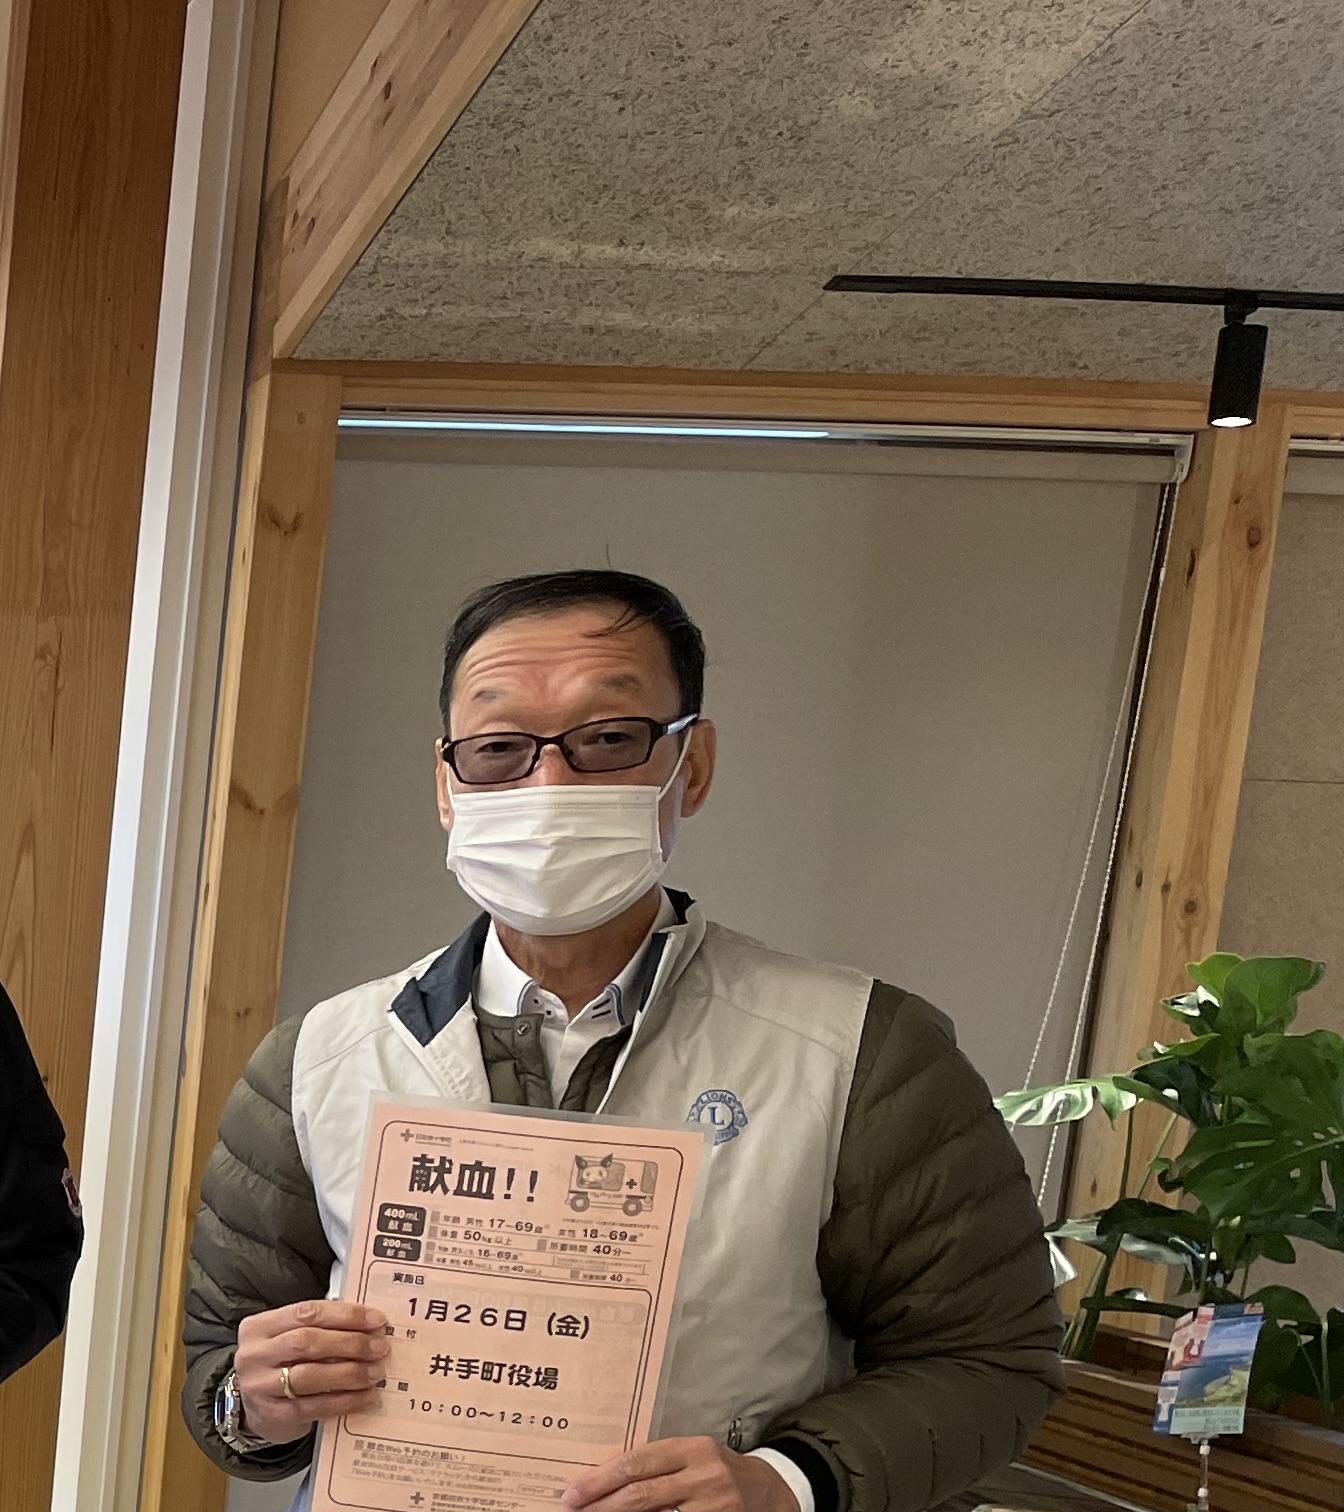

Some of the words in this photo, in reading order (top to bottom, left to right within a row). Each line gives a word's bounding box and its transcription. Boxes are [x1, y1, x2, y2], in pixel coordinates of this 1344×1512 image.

[408, 1153, 539, 1202] 献血!!
[429, 1353, 560, 1391] 井手町役場
